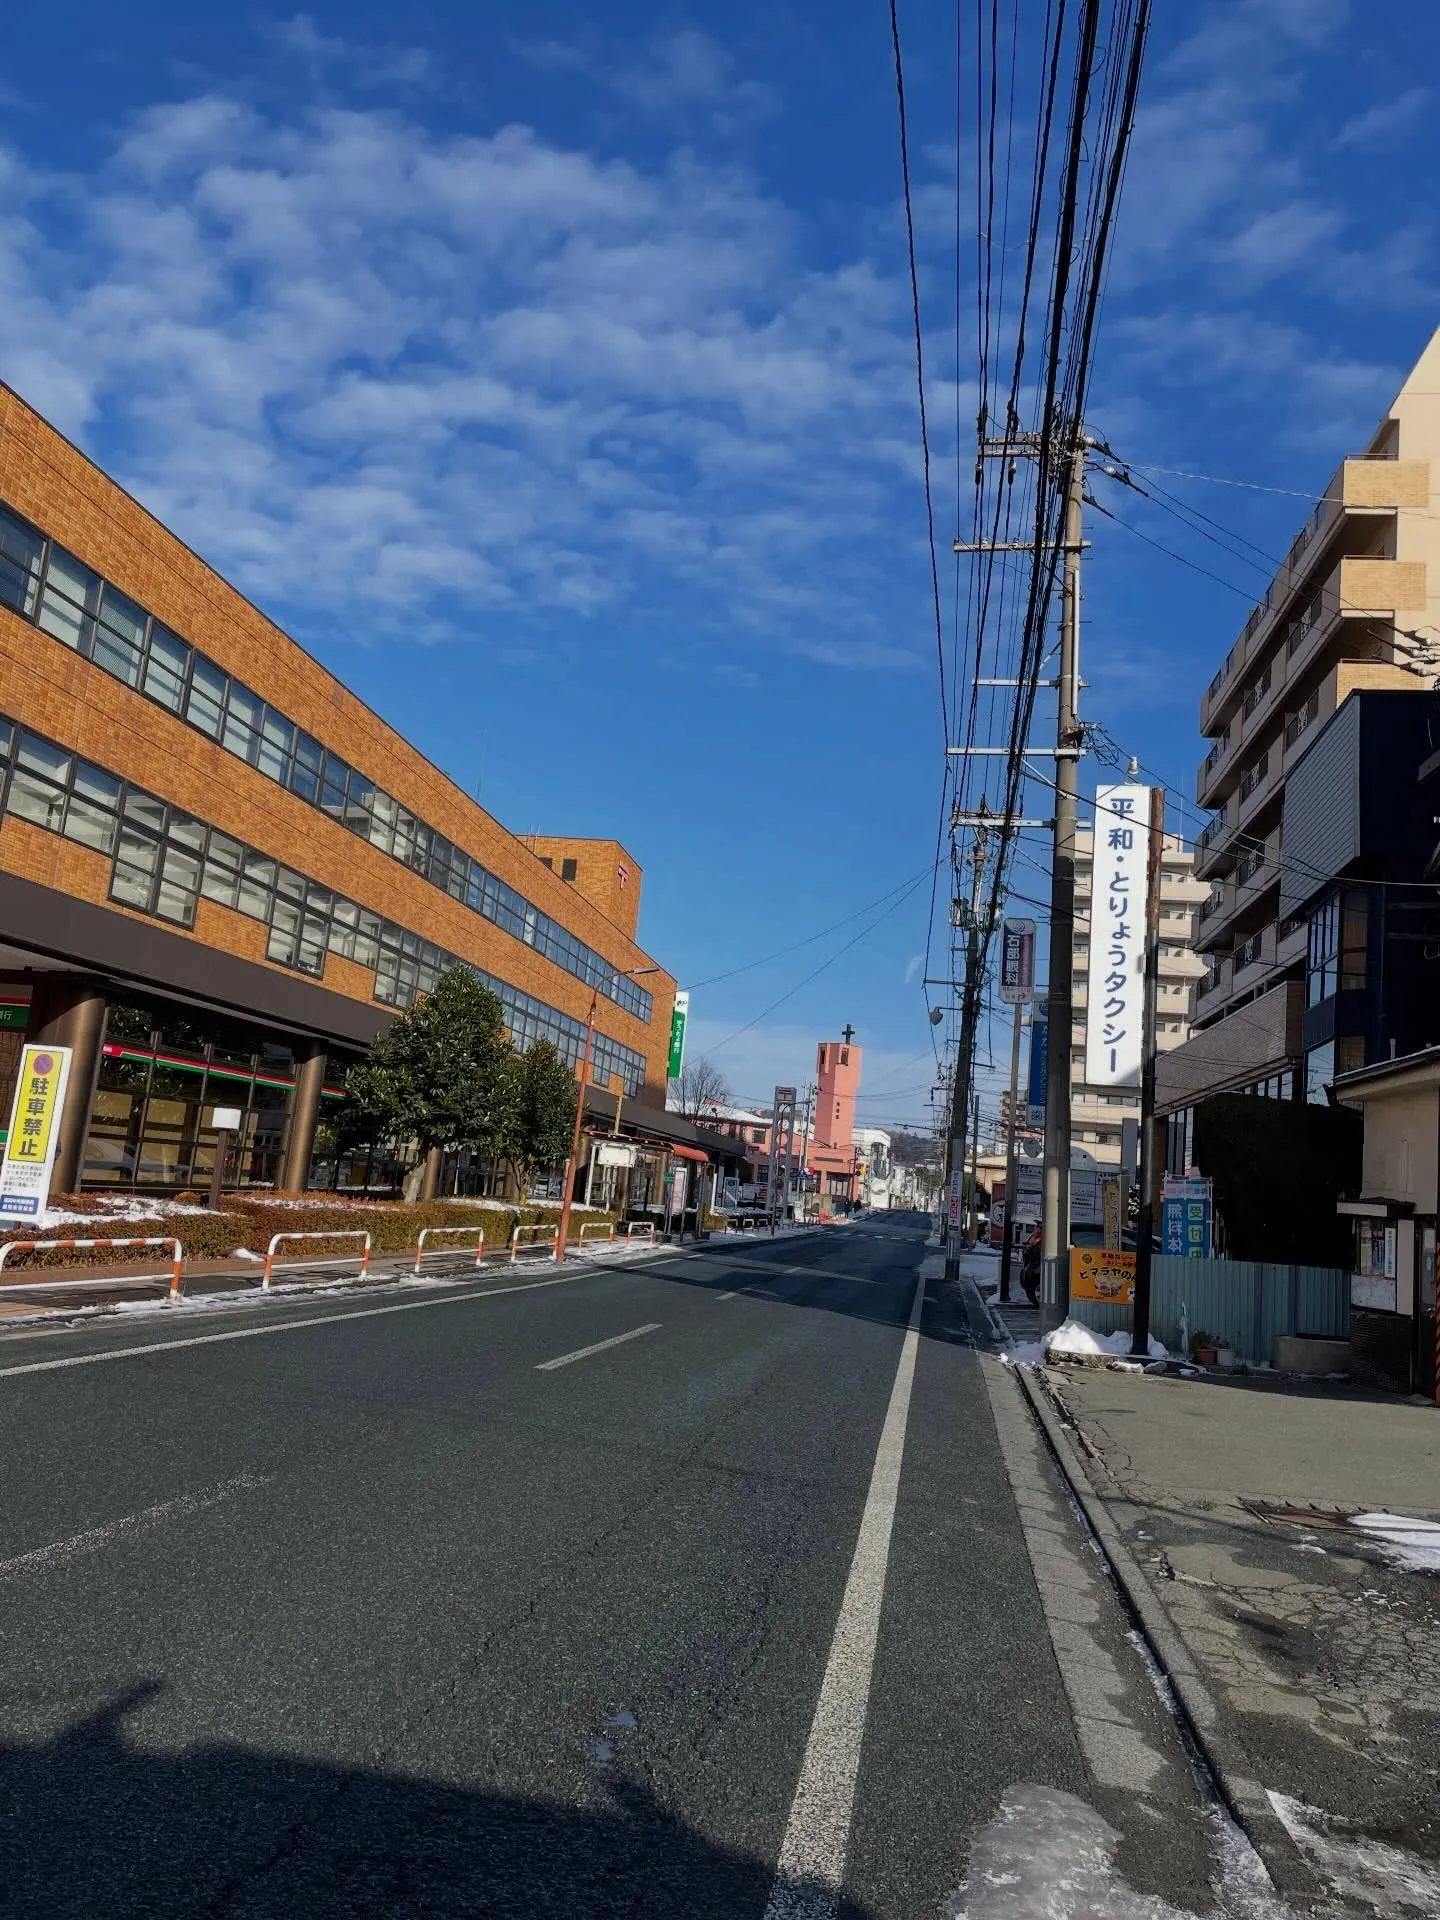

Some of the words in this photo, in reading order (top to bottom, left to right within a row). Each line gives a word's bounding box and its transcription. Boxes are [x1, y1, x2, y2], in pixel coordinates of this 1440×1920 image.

[1005, 934, 1021, 985] 石部眼科
[1103, 797, 1135, 1073] 平和・とりょうタクシー
[19, 1077, 50, 1157] 駐車禁止
